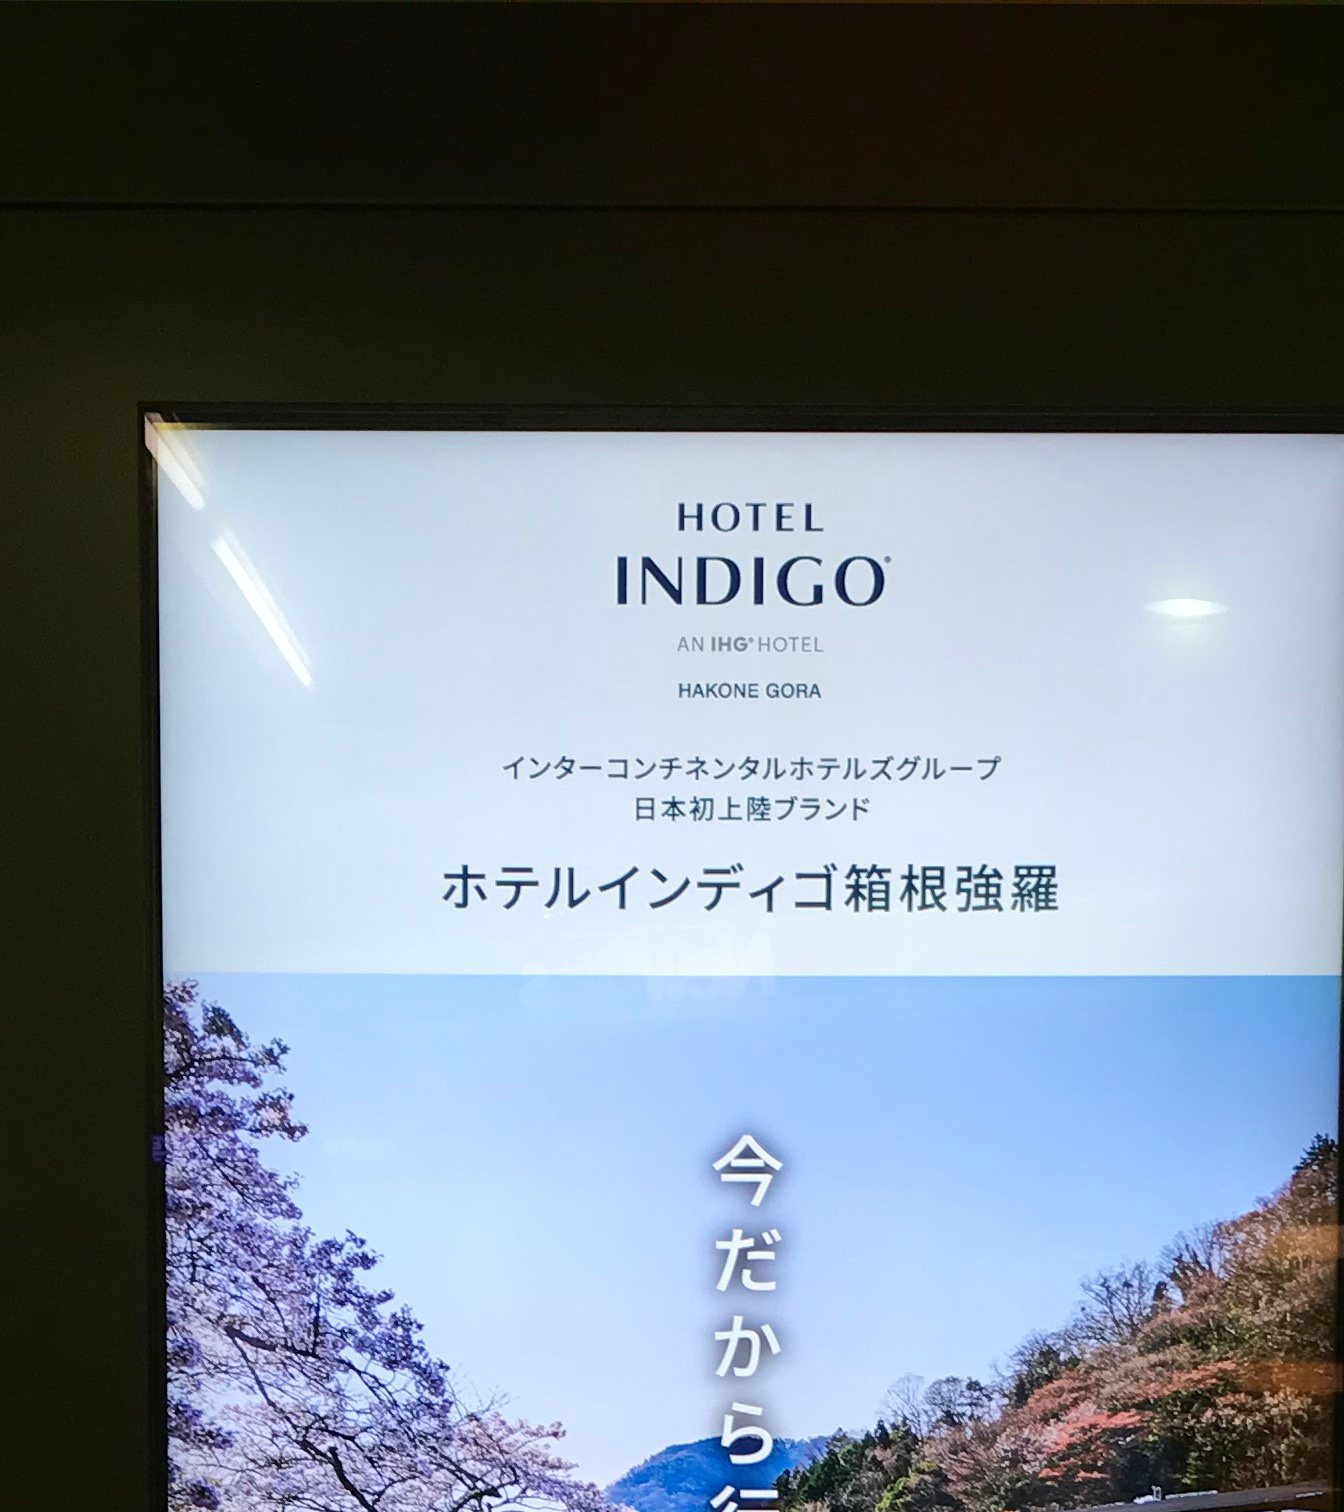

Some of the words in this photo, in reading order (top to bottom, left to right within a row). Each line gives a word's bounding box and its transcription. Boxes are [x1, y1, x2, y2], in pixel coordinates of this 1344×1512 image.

[677, 502, 825, 533] HOTEL
[677, 635, 705, 653] AN
[757, 635, 824, 654] HOTEL
[677, 682, 760, 700] HAKONE
[765, 682, 822, 700] GORA
[501, 755, 1002, 782] インターコンチネンタルホテルズグループ
[634, 795, 871, 823] 日本初上陸ブランド
[442, 863, 1060, 914] ホテルインディゴ箱根強羅
